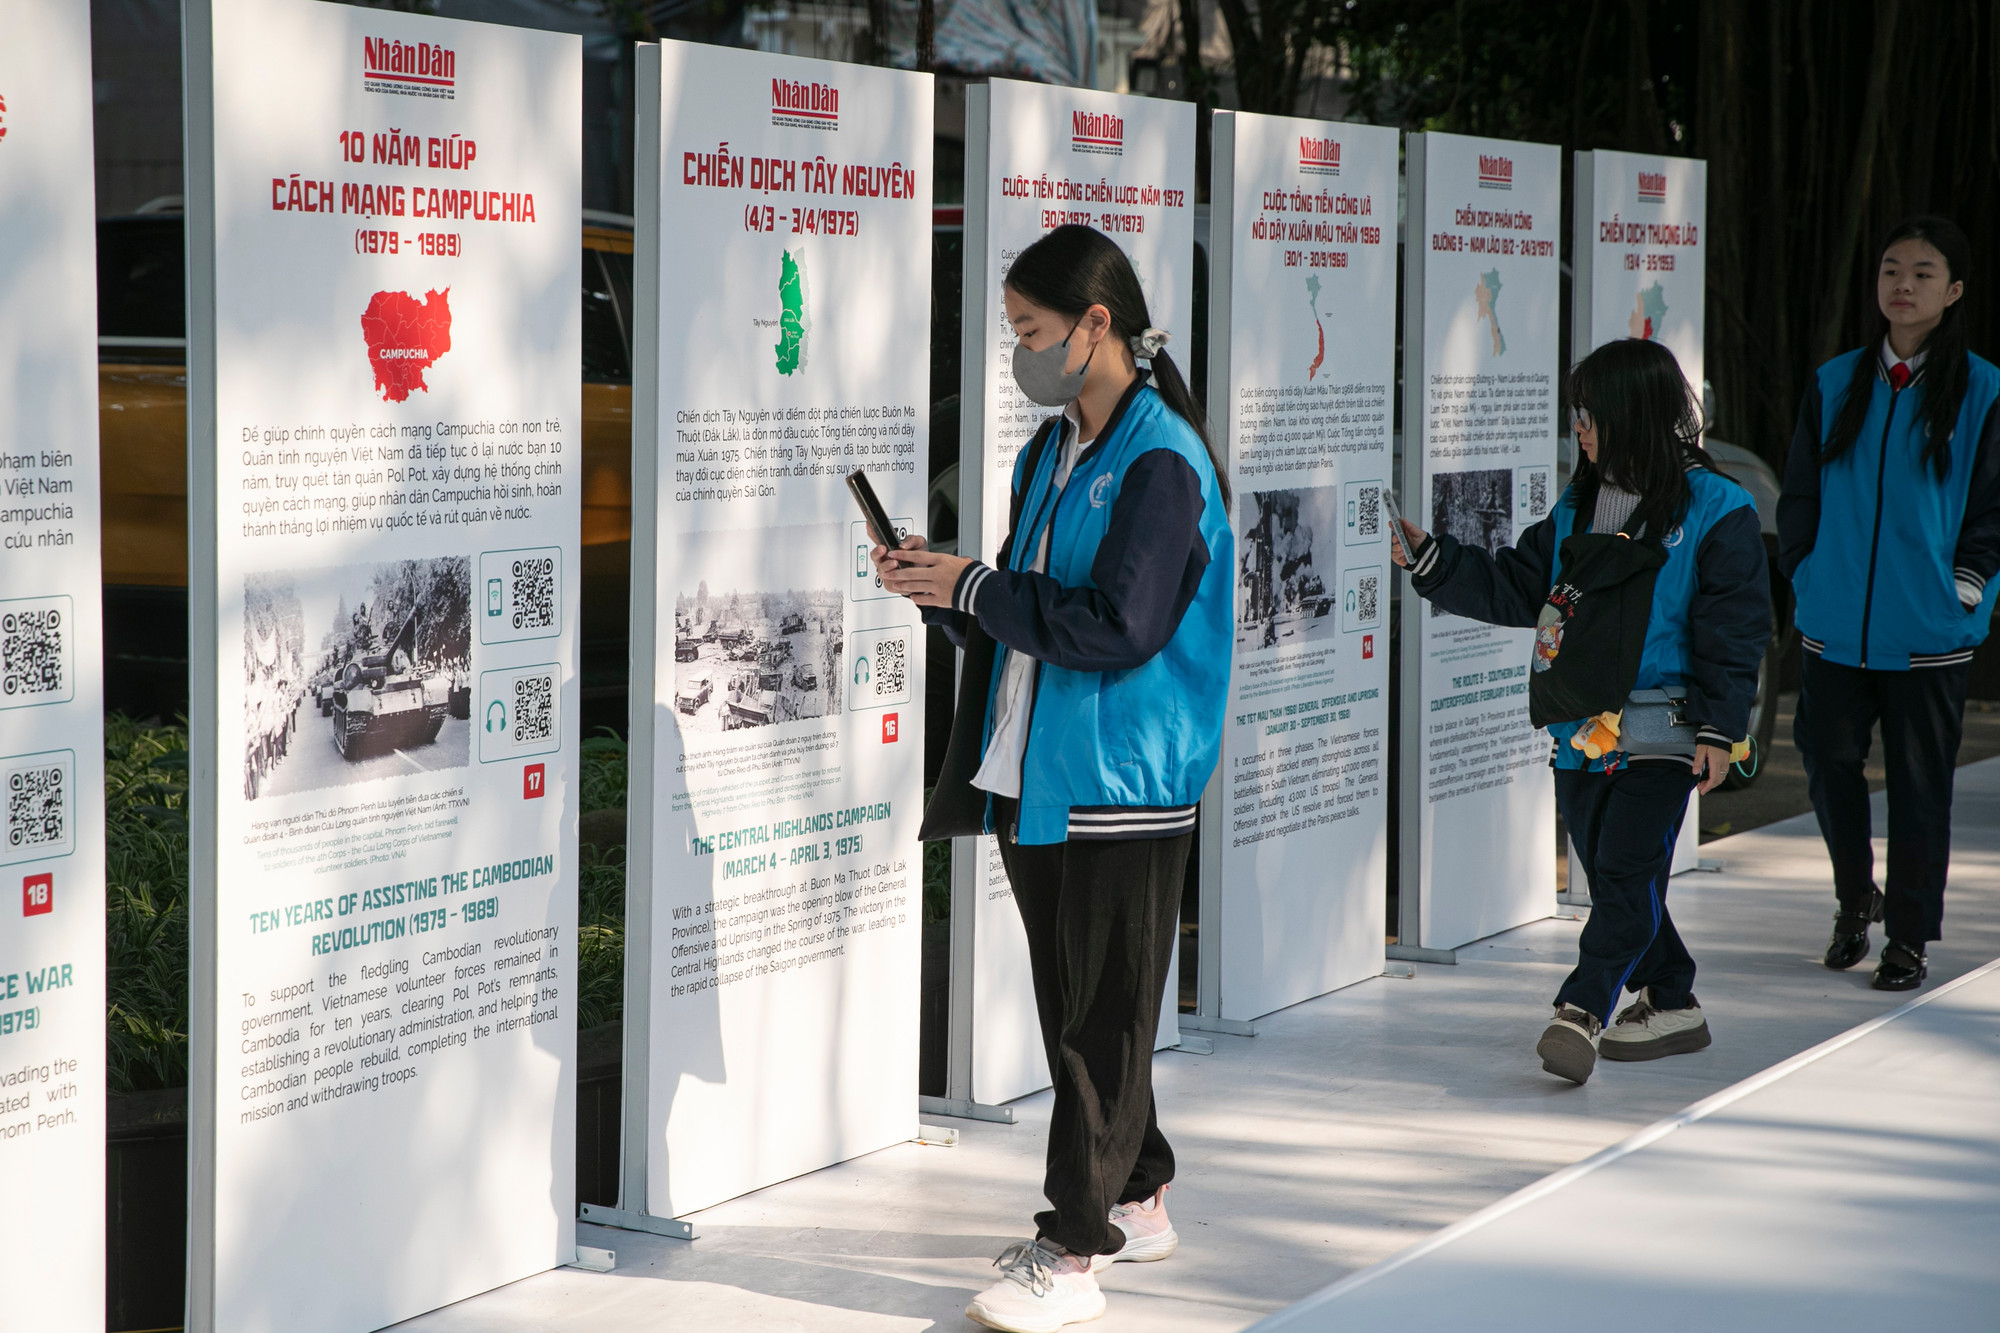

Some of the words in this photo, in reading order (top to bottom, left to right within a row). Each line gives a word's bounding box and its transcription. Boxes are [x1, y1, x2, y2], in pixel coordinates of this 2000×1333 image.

[364, 36, 416, 74] Nhân
[419, 43, 455, 78] Dân
[772, 78, 809, 110] Nhân
[812, 82, 838, 112] Dân
[1072, 111, 1100, 137] Nhân
[1103, 114, 1123, 140] Dân
[340, 131, 364, 162] 10
[373, 127, 420, 166] NĂM
[428, 134, 476, 170] GIÚP
[1300, 136, 1322, 160] Nhân
[1324, 139, 1340, 161] Dân
[684, 142, 743, 188] CHIẾN
[751, 157, 795, 194] DỊCH
[802, 156, 837, 194] TÂY
[843, 162, 914, 199] NGUYÊN
[272, 174, 334, 213] CÁCH
[342, 183, 405, 219] MẠNG
[413, 187, 535, 223] CAMPUCHIA
[1003, 175, 1029, 199] CUỘC
[1033, 174, 1053, 199] TIẾN
[1057, 179, 1082, 200] CÔNG
[1085, 178, 1112, 203] CHIẾN
[1115, 186, 1138, 207] LƯỢC
[1141, 184, 1160, 206] NĂM
[1163, 190, 1183, 207] 1972
[1264, 189, 1287, 213] CUỘC
[1290, 185, 1312, 212] TỔNG
[1315, 188, 1332, 213] TIẾN
[1336, 194, 1358, 215] CÔNG
[1360, 195, 1371, 216] VÀ
[745, 205, 774, 233] (4/3
[792, 208, 858, 236] 3/4/1975)
[1101, 214, 1144, 233] 19/1/1973)
[355, 229, 399, 254] (1979
[418, 233, 461, 257] 1989)
[380, 349, 428, 359] CAMPUCHIA
[242, 426, 258, 443] Để
[264, 425, 289, 445] giúp
[294, 424, 325, 441] chính
[330, 422, 365, 445] quyền
[370, 422, 396, 438] cách
[401, 424, 431, 441] mạng
[436, 421, 494, 439] Campuchia
[499, 420, 518, 434] còn
[522, 422, 541, 434] non
[546, 418, 561, 434] trẻ,
[41, 451, 72, 468] biên
[4, 477, 34, 498] Việt
[38, 478, 72, 494] Nam
[5, 531, 32, 549] cứu
[38, 529, 73, 547] nhân
[1364, 641, 1371, 653] 14
[886, 721, 895, 736] 16
[528, 772, 541, 790] 17
[693, 835, 715, 856] THE
[720, 826, 769, 851] CENTRAL
[774, 813, 833, 841] HIGHLANDS
[836, 802, 891, 828] CAMPAIGN
[723, 855, 766, 880] (MARCH
[770, 855, 776, 870] 4
[790, 842, 820, 866] APRIL
[823, 841, 832, 861] 3,
[836, 834, 863, 857] 1975)
[28, 884, 48, 906] 18
[250, 910, 280, 934] TEN
[286, 898, 333, 926] YEARS
[338, 893, 357, 916] OF
[363, 878, 437, 911] ASSISTING
[441, 872, 467, 893] THE
[473, 855, 553, 889] CAMBODIAN
[673, 906, 692, 920] With
[696, 906, 700, 916] a
[705, 896, 739, 914] strategic
[744, 884, 796, 905] breakthrough
[800, 883, 807, 892] at
[811, 878, 830, 890] Buon
[834, 872, 846, 884] Ma
[849, 867, 870, 883] Thuot
[874, 863, 890, 877] (Dak
[894, 859, 907, 871] Lak
[313, 917, 404, 956] REVOLUTION
[410, 908, 446, 935] (1979
[462, 896, 498, 923] 1989)
[26, 964, 73, 994] WAR
[242, 994, 255, 1008] To
[271, 982, 314, 1004] support
[329, 973, 346, 988] the
[361, 959, 408, 980] fledgling
[423, 942, 481, 966] Cambodian
[494, 926, 558, 949] revolutionary
[54, 1057, 77, 1074] the
[48, 1081, 77, 1101] with
[38, 1107, 77, 1130] Penh.
